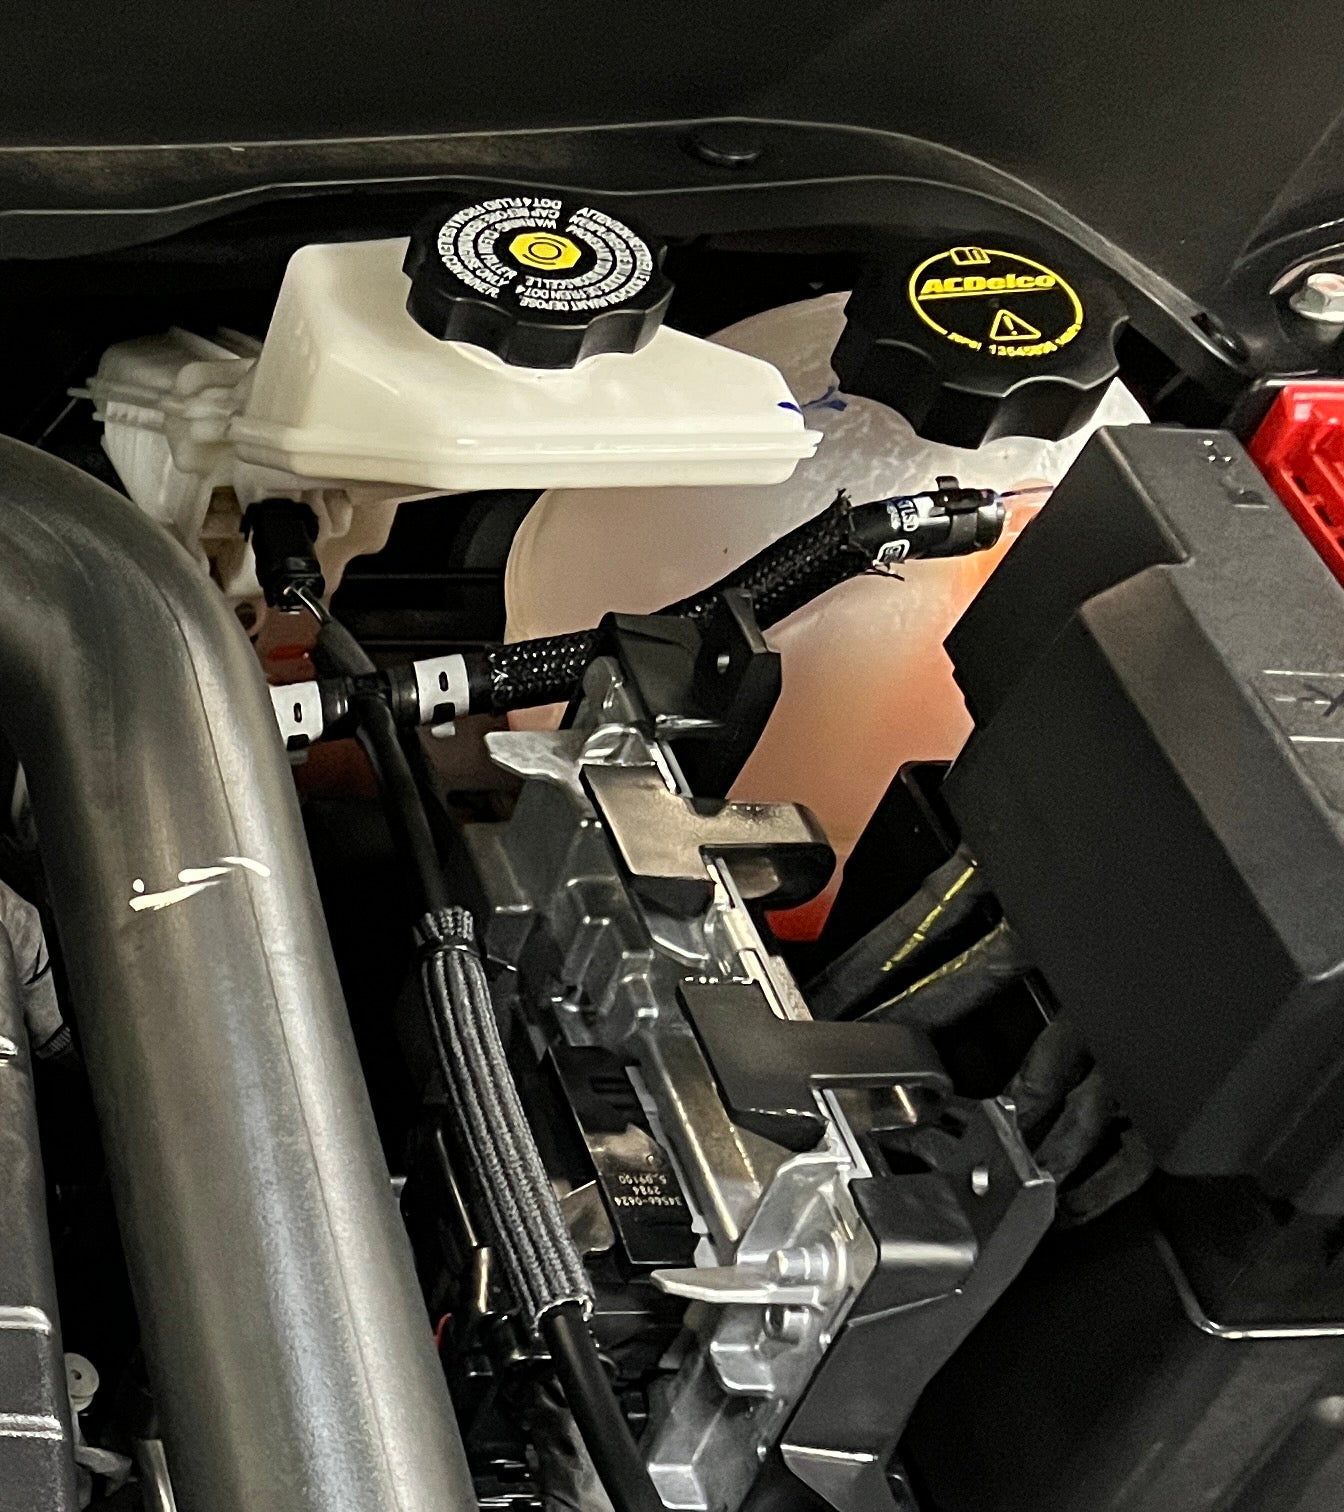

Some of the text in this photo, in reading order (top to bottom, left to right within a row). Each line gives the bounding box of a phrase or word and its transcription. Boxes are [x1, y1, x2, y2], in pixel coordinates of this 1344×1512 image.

[483, 198, 522, 210] FLUID
[534, 198, 562, 211] DOT
[531, 208, 560, 219] CAP
[481, 254, 517, 282] FILLER
[471, 268, 509, 290] ONLY
[919, 272, 1057, 295] ACDelco
[522, 287, 552, 302] DOT
[551, 289, 592, 303] FREIN
[571, 297, 608, 311] AVANT
